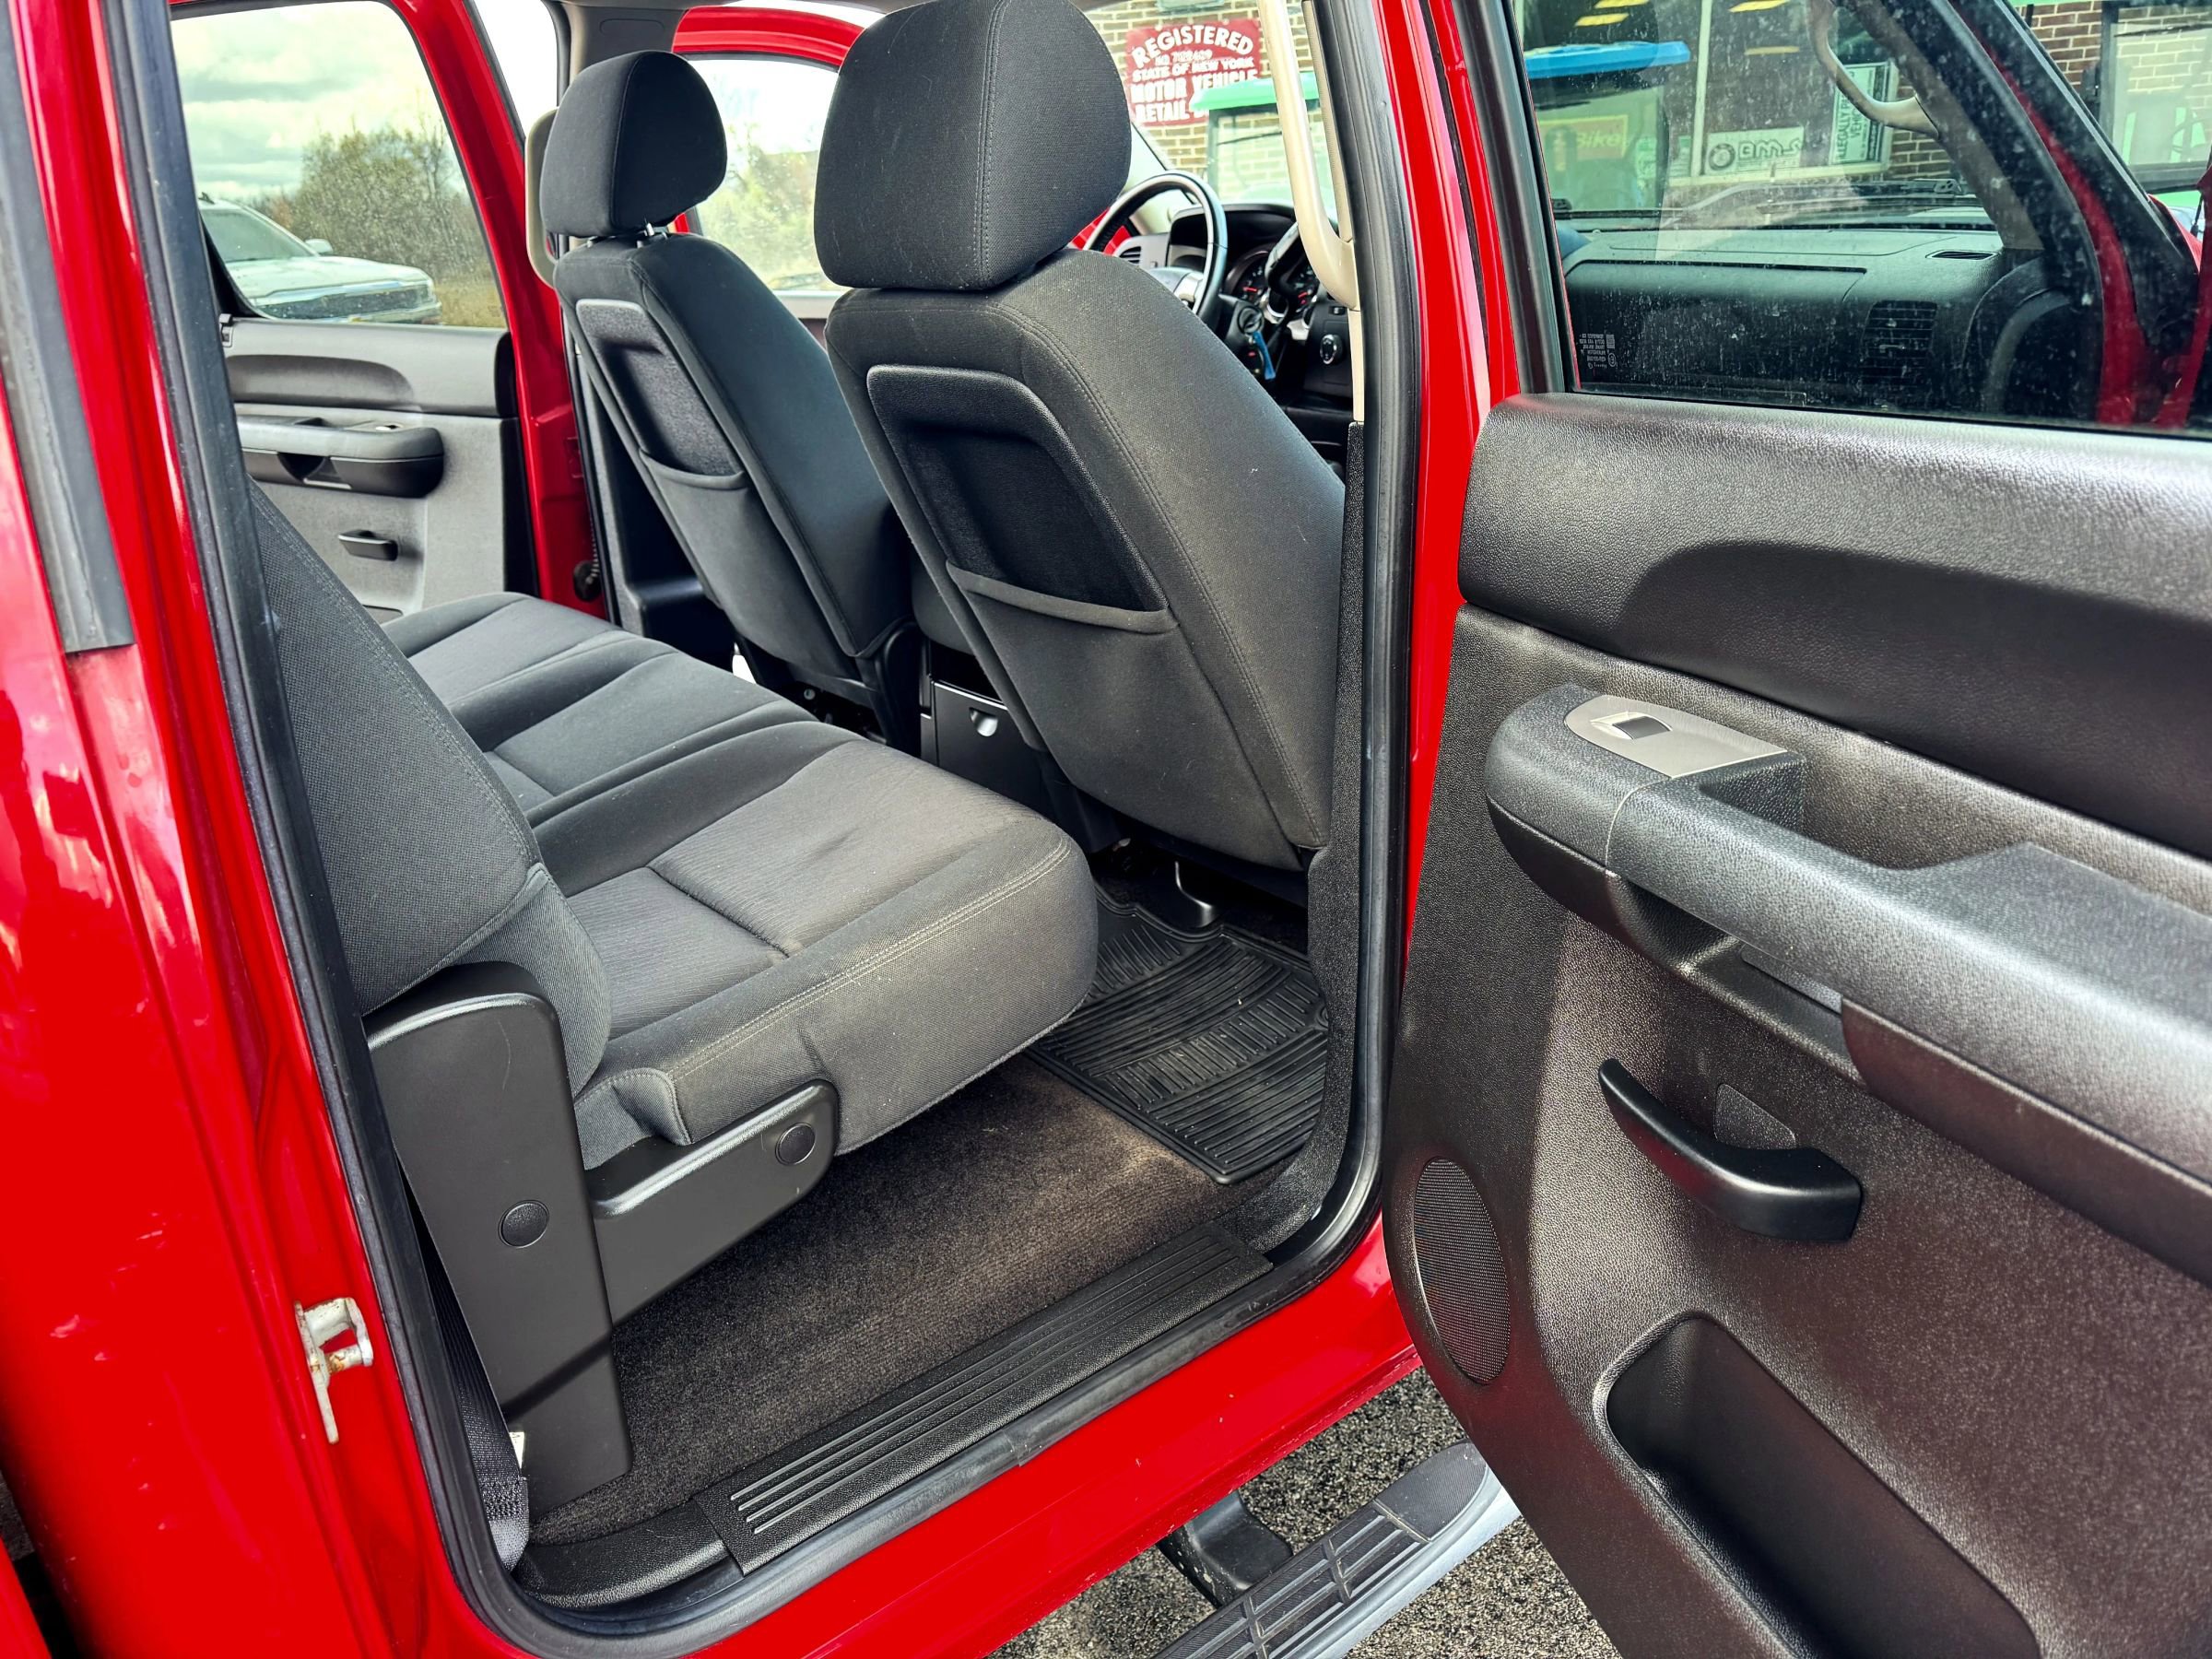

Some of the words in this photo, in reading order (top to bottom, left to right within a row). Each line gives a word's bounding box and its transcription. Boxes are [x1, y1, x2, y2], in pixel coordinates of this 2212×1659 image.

[1131, 24, 1254, 69] REGISTERED
[1132, 65, 1171, 83] STATE
[1171, 61, 1190, 76] OF
[1191, 59, 1219, 74] NEW
[1221, 56, 1255, 70] YORK
[1130, 77, 1188, 103] MOTOR
[1135, 100, 1191, 123] RETAIL
